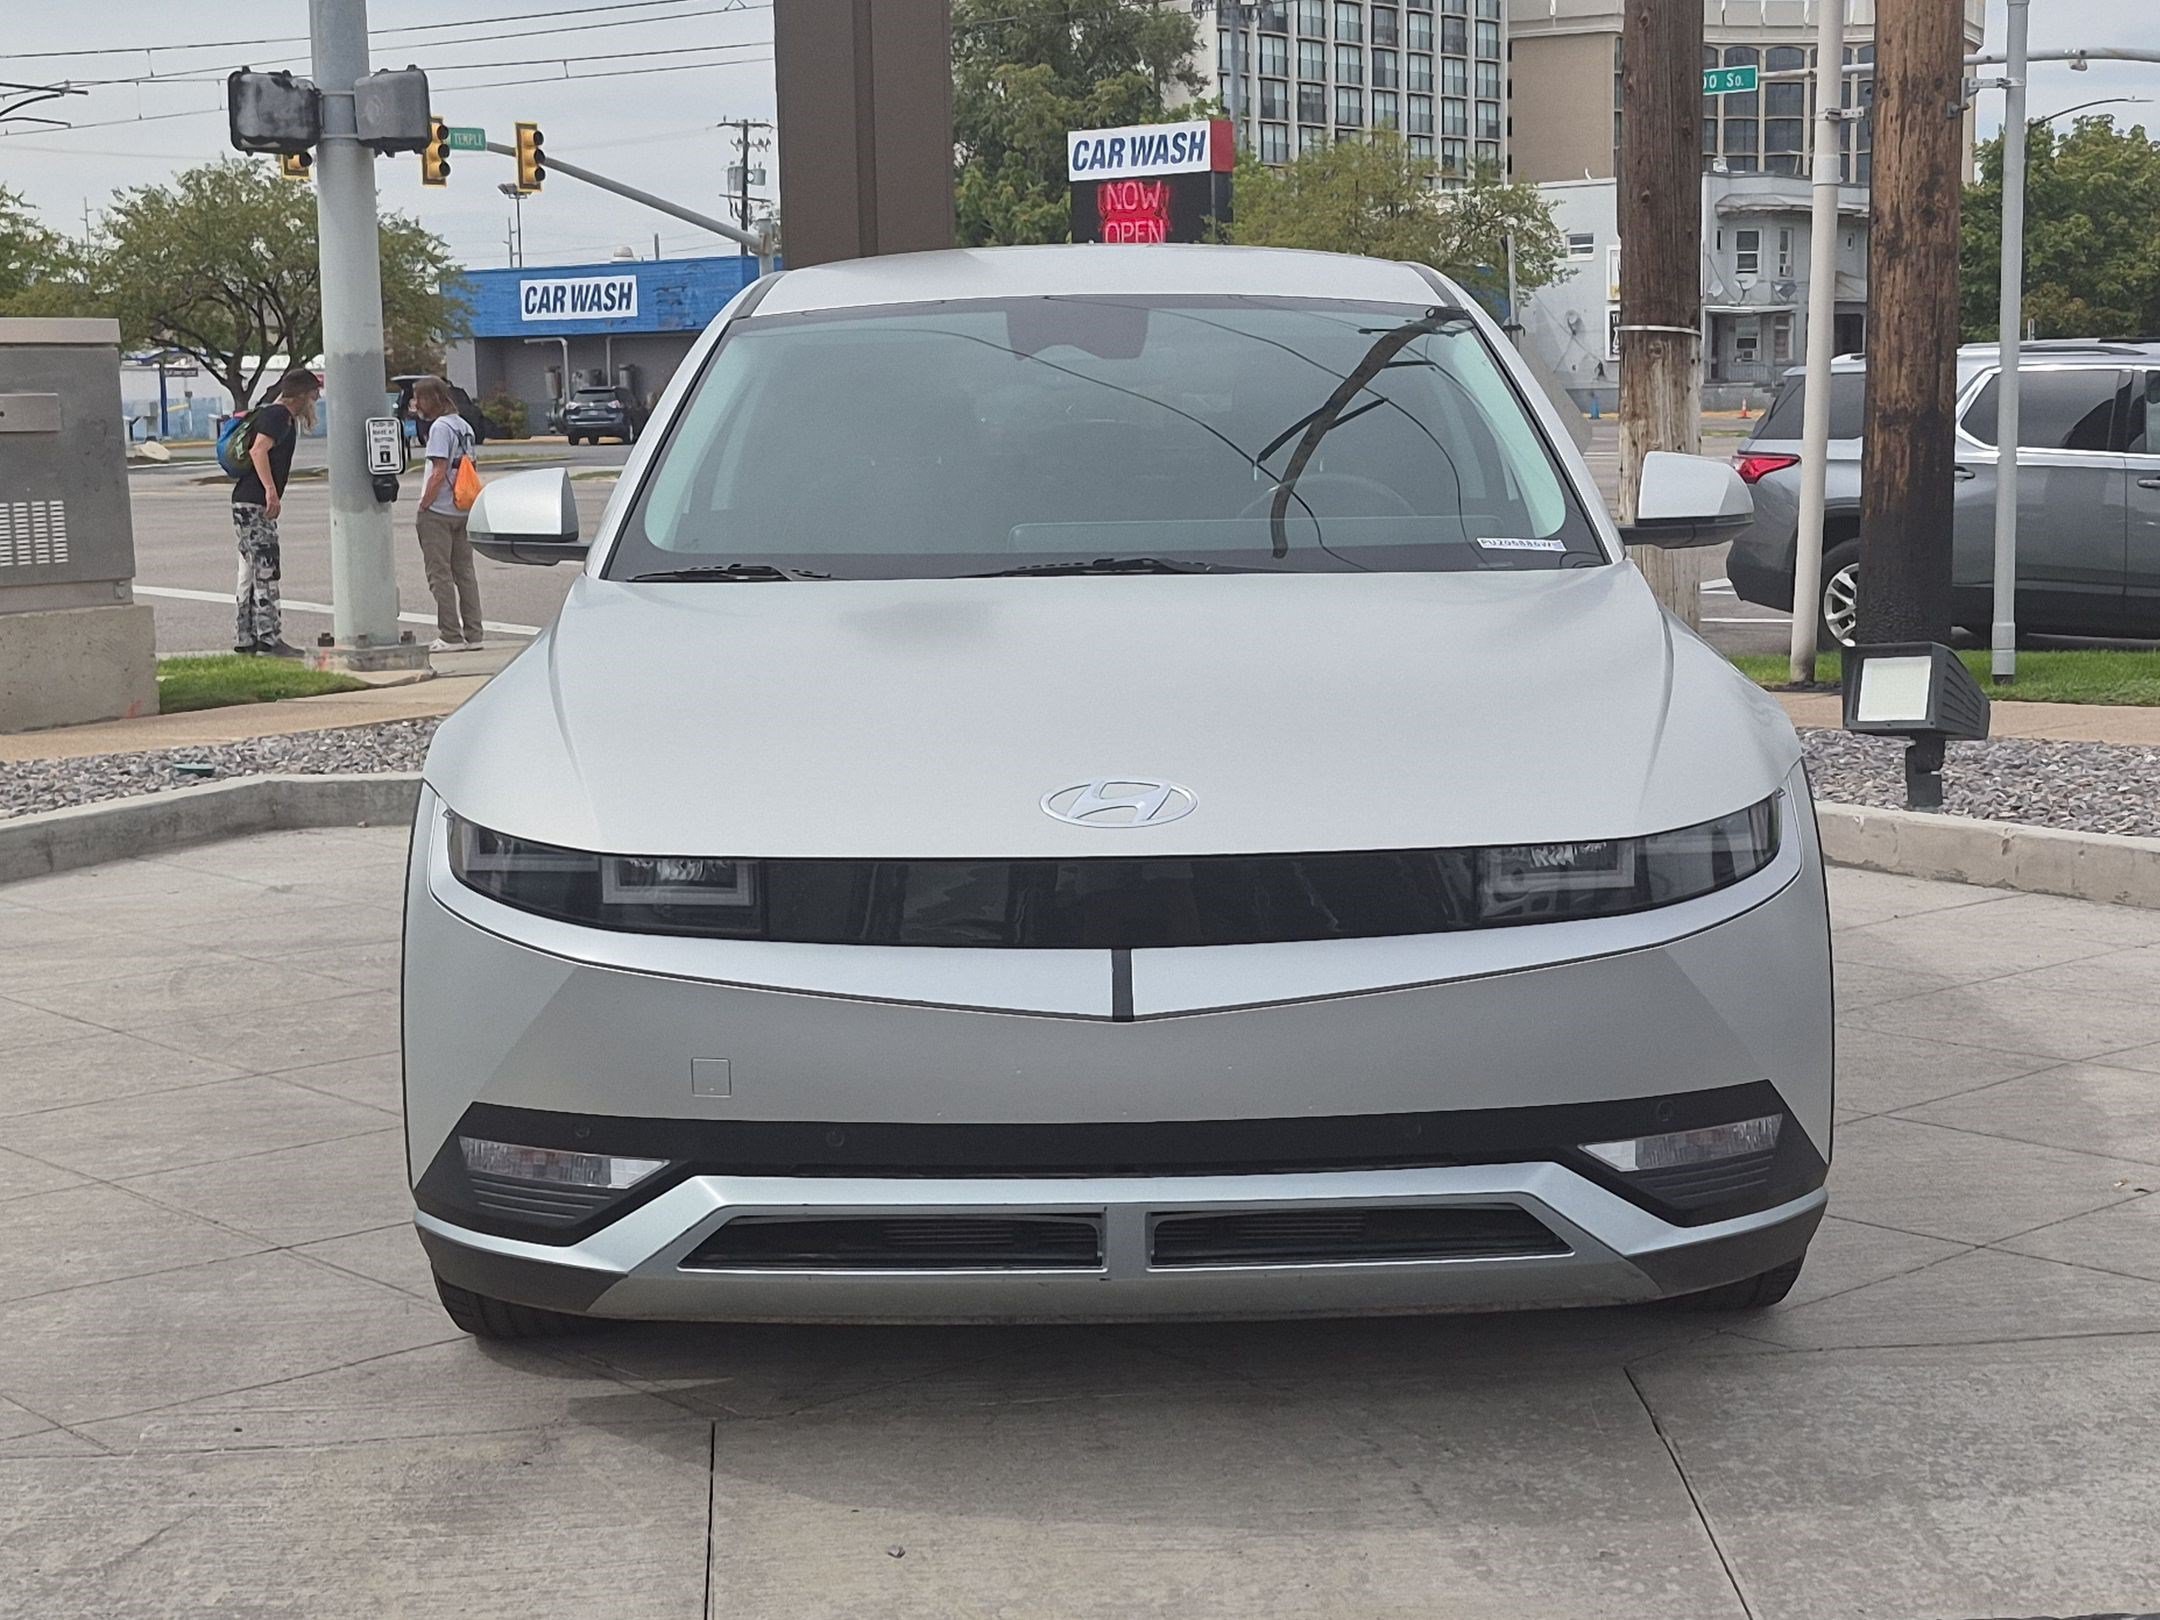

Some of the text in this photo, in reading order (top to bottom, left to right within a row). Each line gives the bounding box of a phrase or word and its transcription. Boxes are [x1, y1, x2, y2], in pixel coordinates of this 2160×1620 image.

[453, 132, 483, 146] TEMPLE
[1072, 129, 1207, 172] CAR WASH
[1106, 180, 1161, 210] NOW
[1105, 219, 1165, 244] OPEN
[525, 281, 633, 315] CAR WASH
